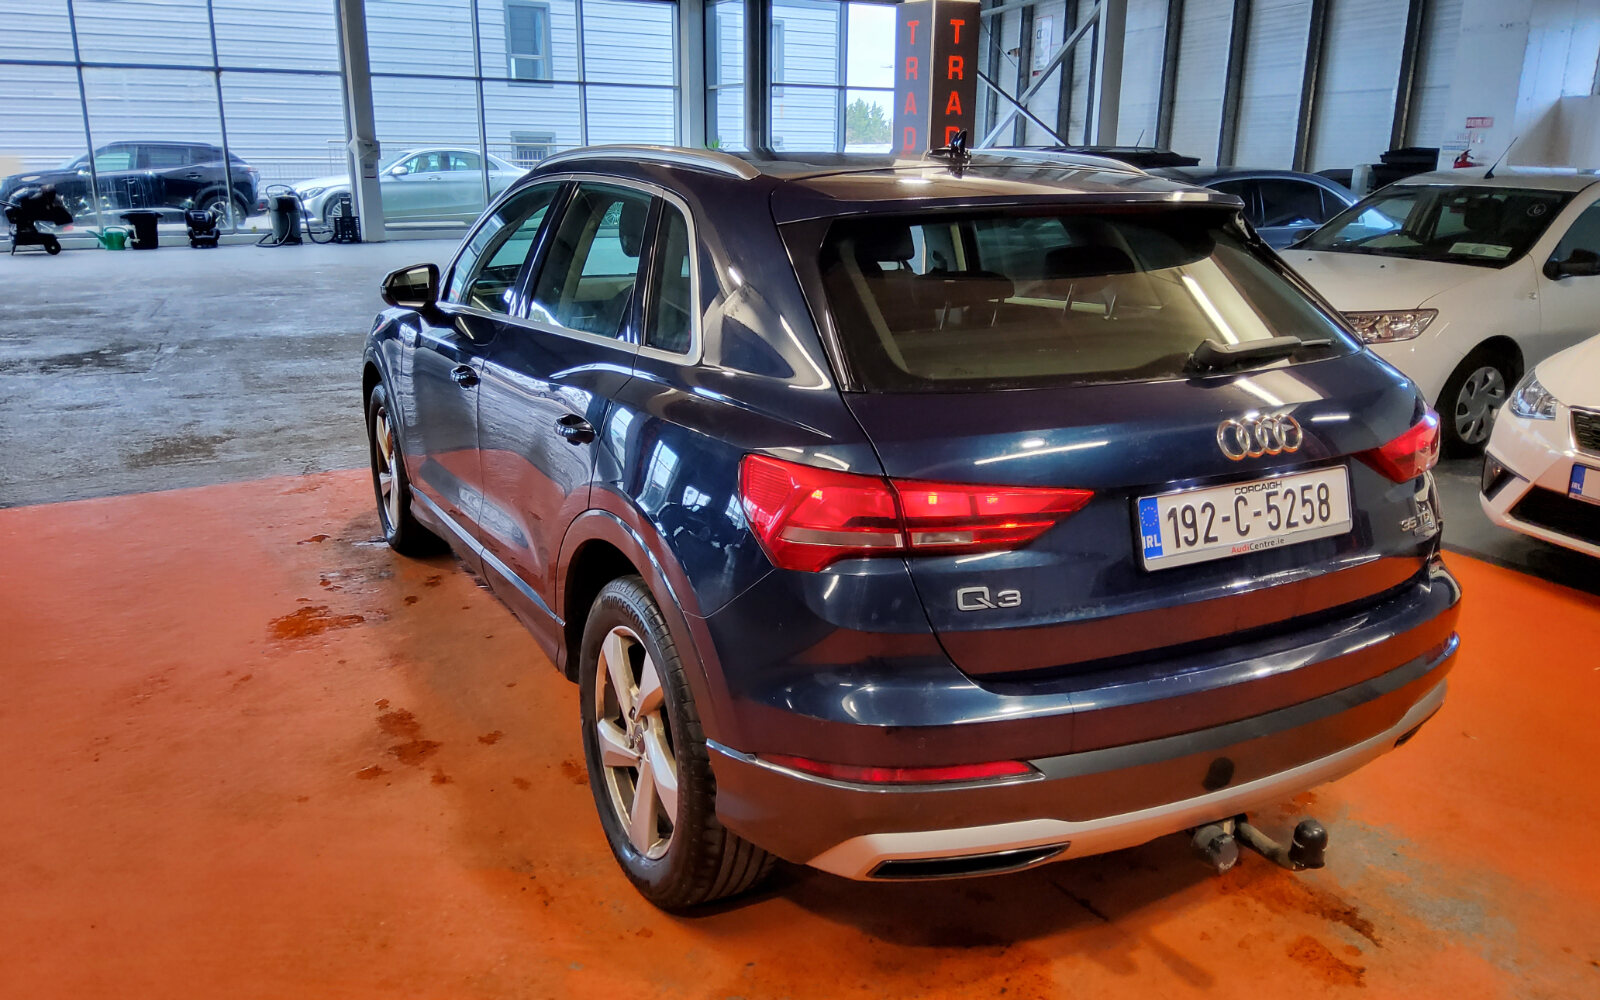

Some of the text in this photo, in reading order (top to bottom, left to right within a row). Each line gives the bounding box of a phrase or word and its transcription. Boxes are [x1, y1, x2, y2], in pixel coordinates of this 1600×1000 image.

[1234, 480, 1283, 495] CORCAIGH
[1571, 481, 1582, 491] IRL
[1167, 482, 1331, 549] 192-C-5258
[1141, 533, 1162, 550] IRL
[1231, 537, 1285, 554] AudiCentre.ie
[956, 586, 1022, 611] Q3
